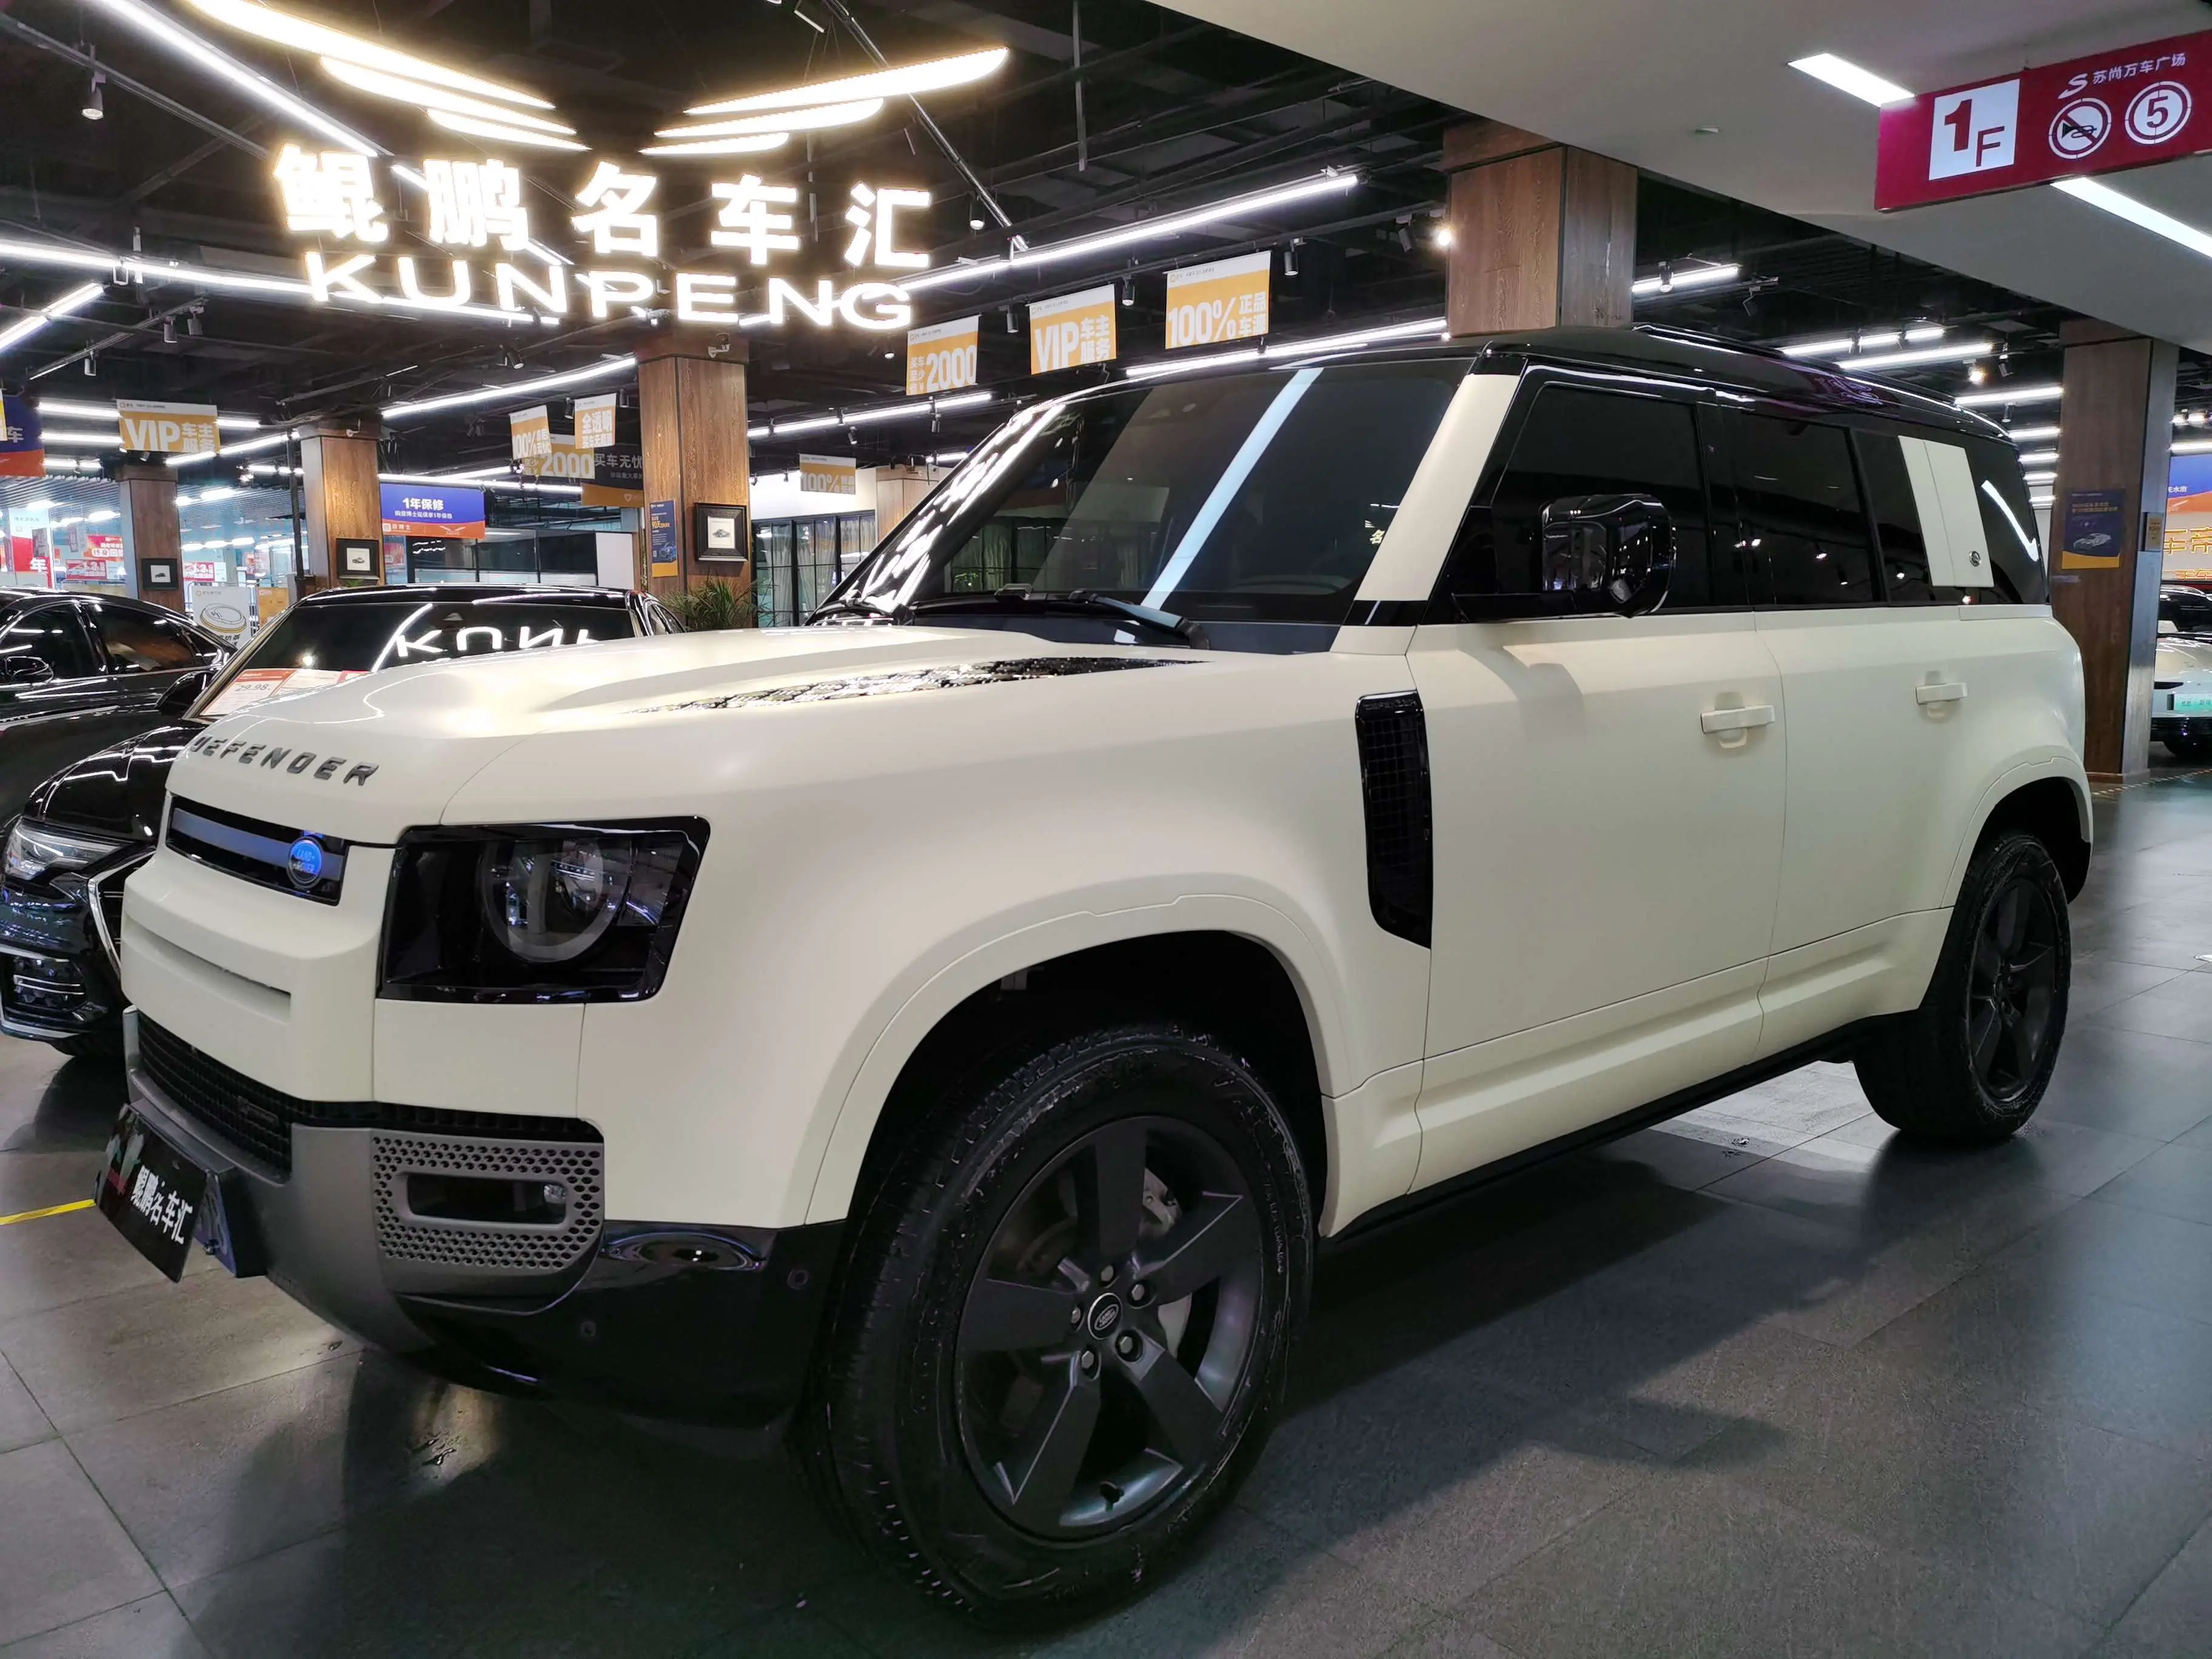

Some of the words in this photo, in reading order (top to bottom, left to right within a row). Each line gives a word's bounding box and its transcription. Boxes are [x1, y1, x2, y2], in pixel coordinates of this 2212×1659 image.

[2093, 53, 2187, 85] 苏尚万车广场
[2147, 95, 2169, 129] 5
[1944, 99, 2005, 167] 1F
[272, 142, 931, 268] 鲲鹏名车汇
[304, 251, 911, 330] KUNPENG
[1239, 291, 1266, 314] 正品
[1081, 315, 1110, 340] 车主
[1168, 297, 1236, 349] 100%
[1239, 313, 1266, 335] 车源
[1034, 321, 1079, 372] VIP
[1081, 338, 1110, 364] 服务
[925, 344, 976, 394] 2000
[124, 418, 181, 452] VIP
[540, 451, 594, 478] 2000
[402, 497, 444, 511] 1年保修
[190, 736, 380, 786] DEFENDER
